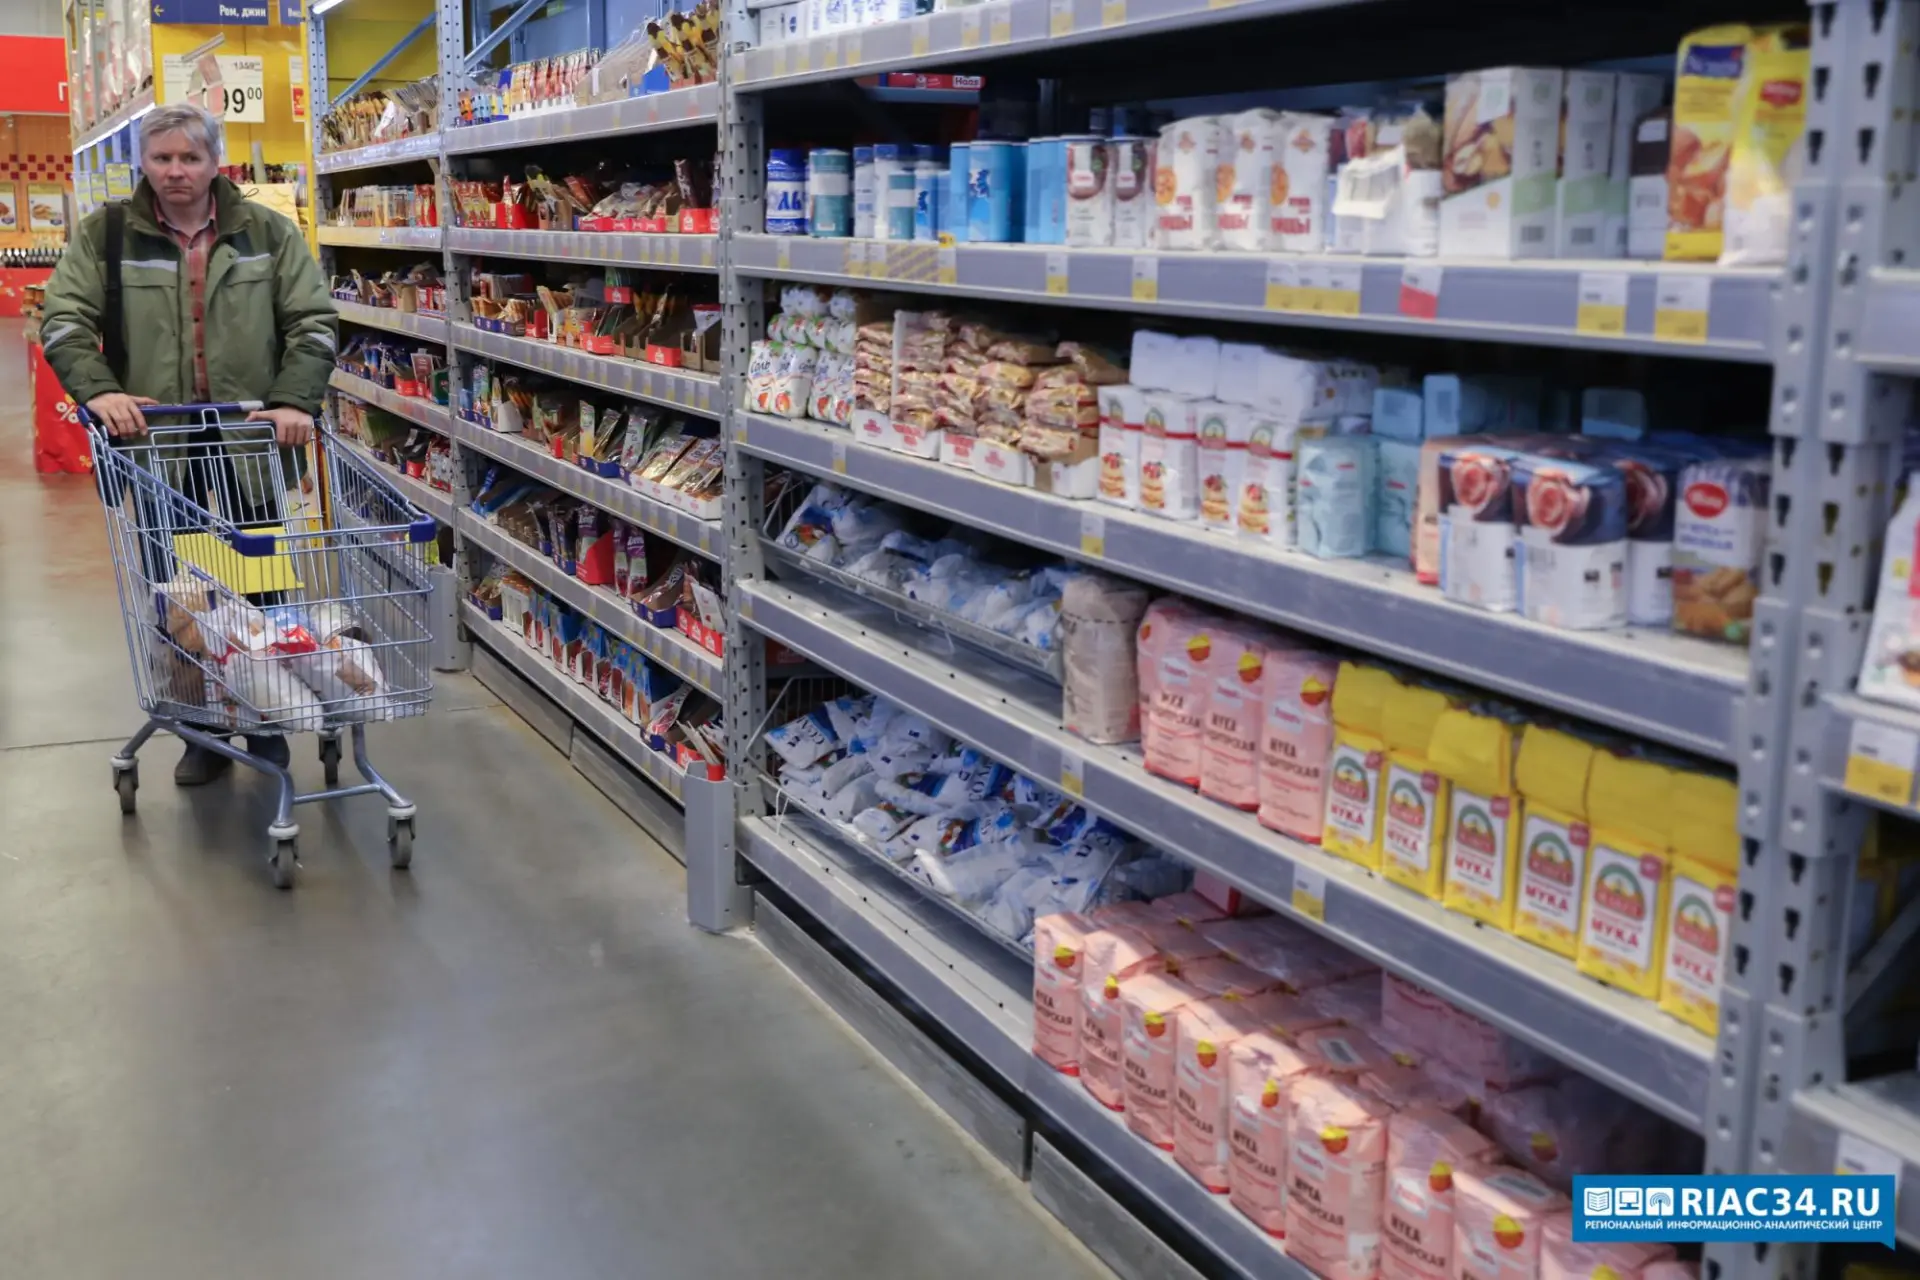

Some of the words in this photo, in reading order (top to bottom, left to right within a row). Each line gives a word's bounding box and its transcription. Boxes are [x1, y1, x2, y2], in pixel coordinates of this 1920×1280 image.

[220, 4, 239, 17] Ром,
[241, 7, 266, 17] джин
[1331, 804, 1365, 826] МУКА
[1386, 830, 1419, 853] МУКА
[1455, 854, 1493, 882] МУКА
[1525, 885, 1568, 913] МУКА
[1592, 917, 1639, 948] МУКА
[1673, 953, 1714, 985] МУКА
